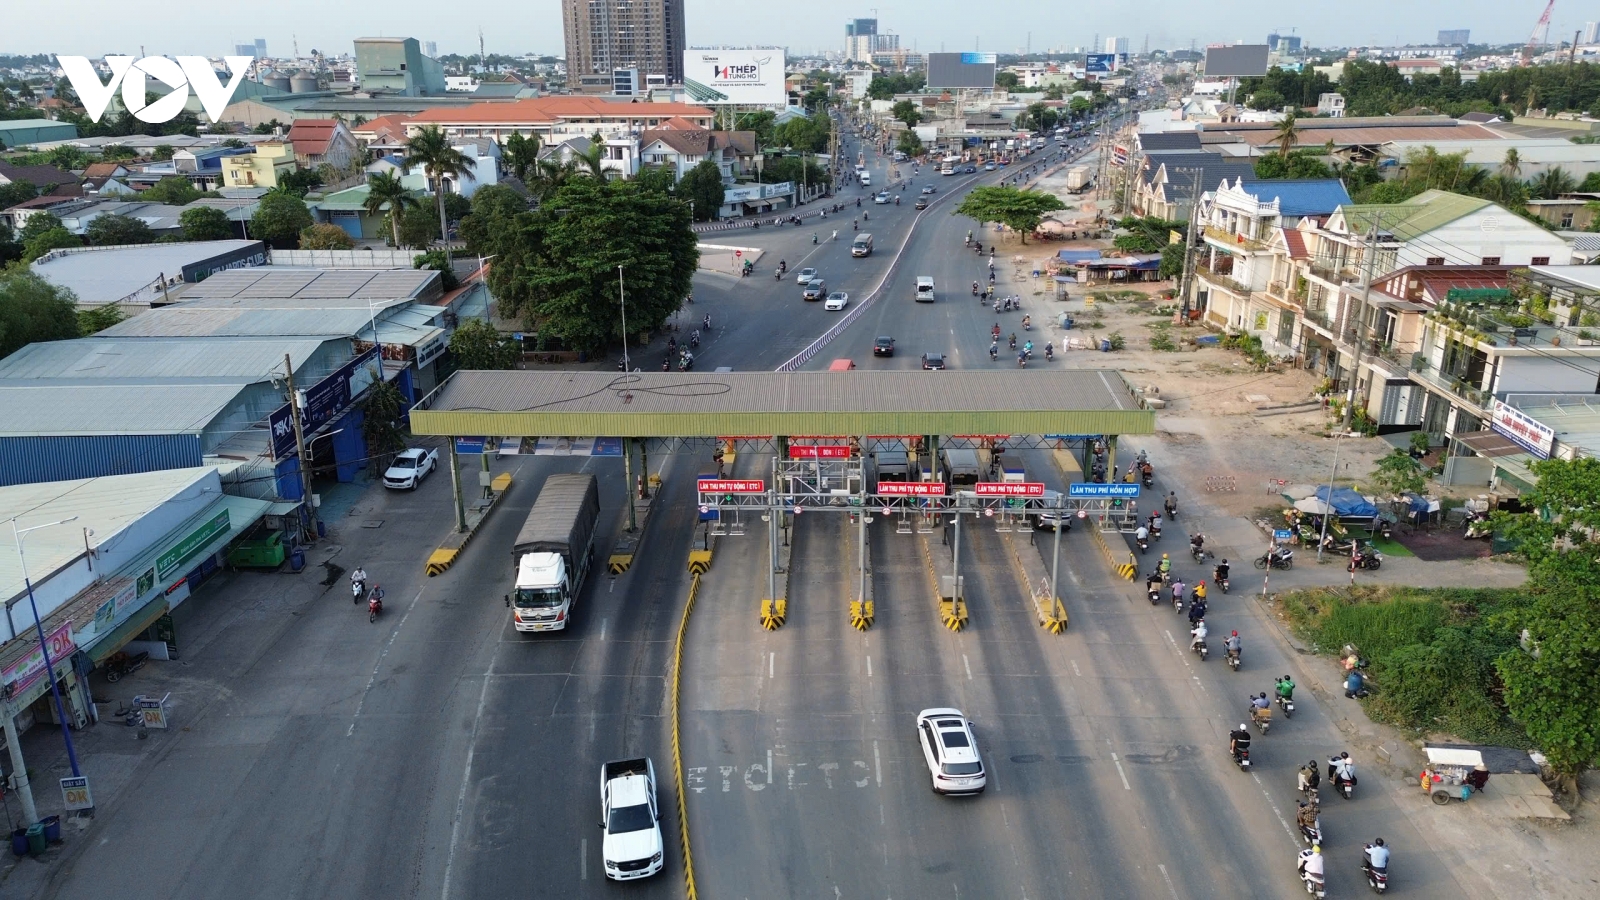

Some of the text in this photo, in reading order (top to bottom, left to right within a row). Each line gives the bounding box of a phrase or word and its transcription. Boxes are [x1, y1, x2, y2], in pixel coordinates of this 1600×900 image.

[730, 64, 756, 73] THÉP
[734, 482, 746, 491] ĐỘNG
[915, 485, 928, 494] ĐỘNG
[1013, 485, 1026, 494] ĐỘNG
[159, 553, 176, 570] VETC
[53, 630, 71, 655] OK
[145, 712, 162, 724] OK
[66, 790, 88, 804] OK
